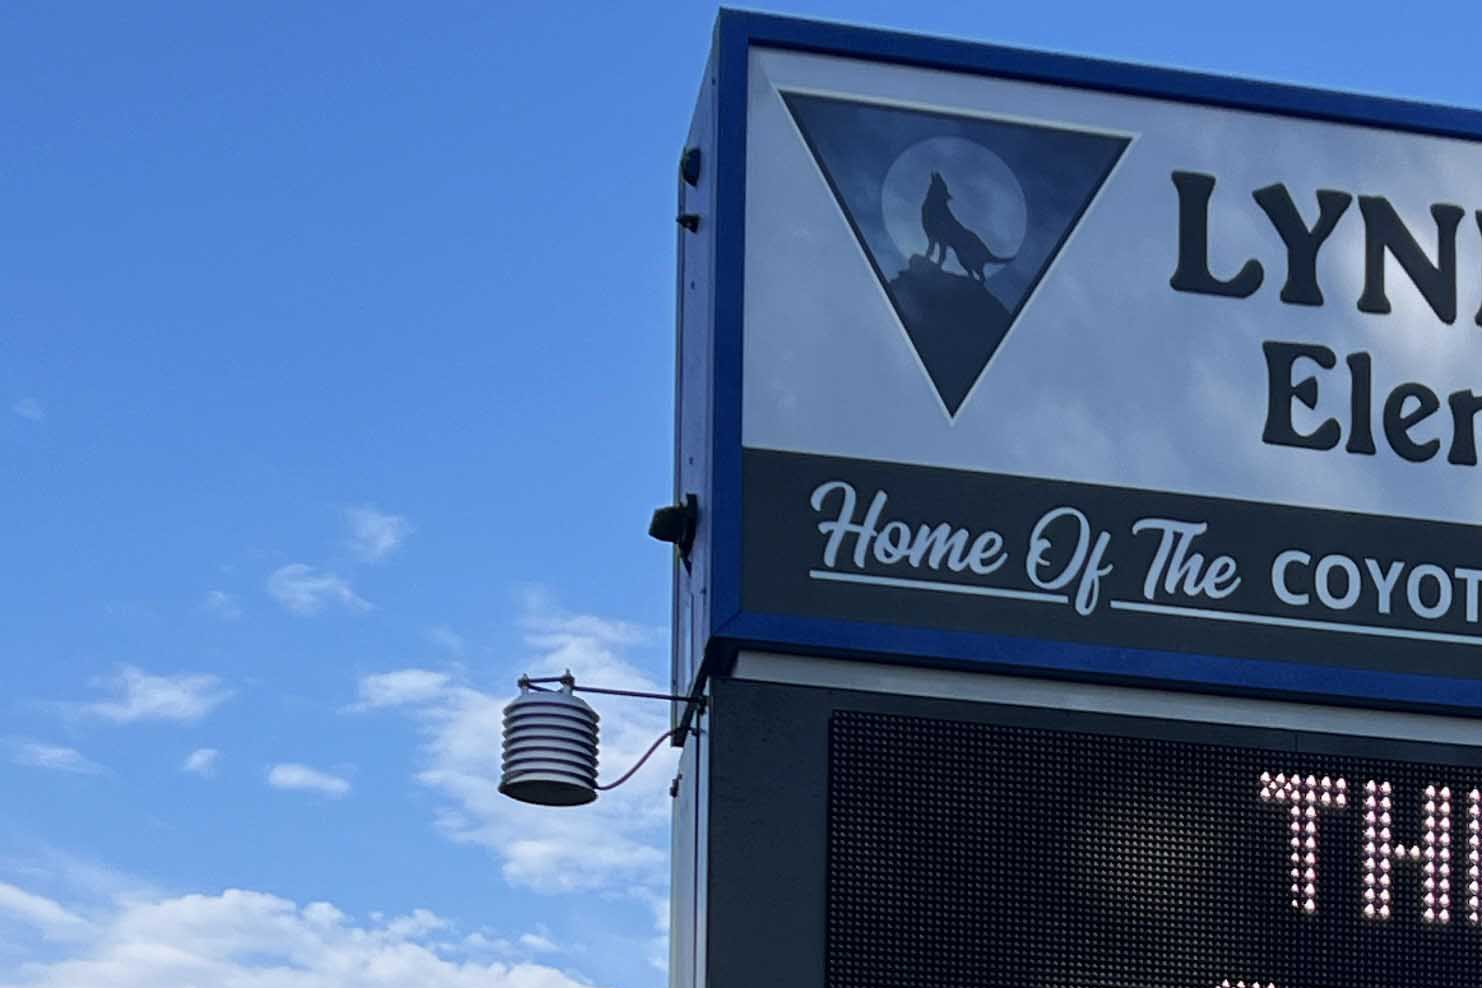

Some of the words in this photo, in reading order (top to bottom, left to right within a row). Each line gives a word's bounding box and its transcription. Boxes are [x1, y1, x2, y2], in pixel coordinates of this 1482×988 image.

[809, 481, 1008, 574] Home
[1025, 506, 1111, 617] Of
[1131, 518, 1242, 602] The
